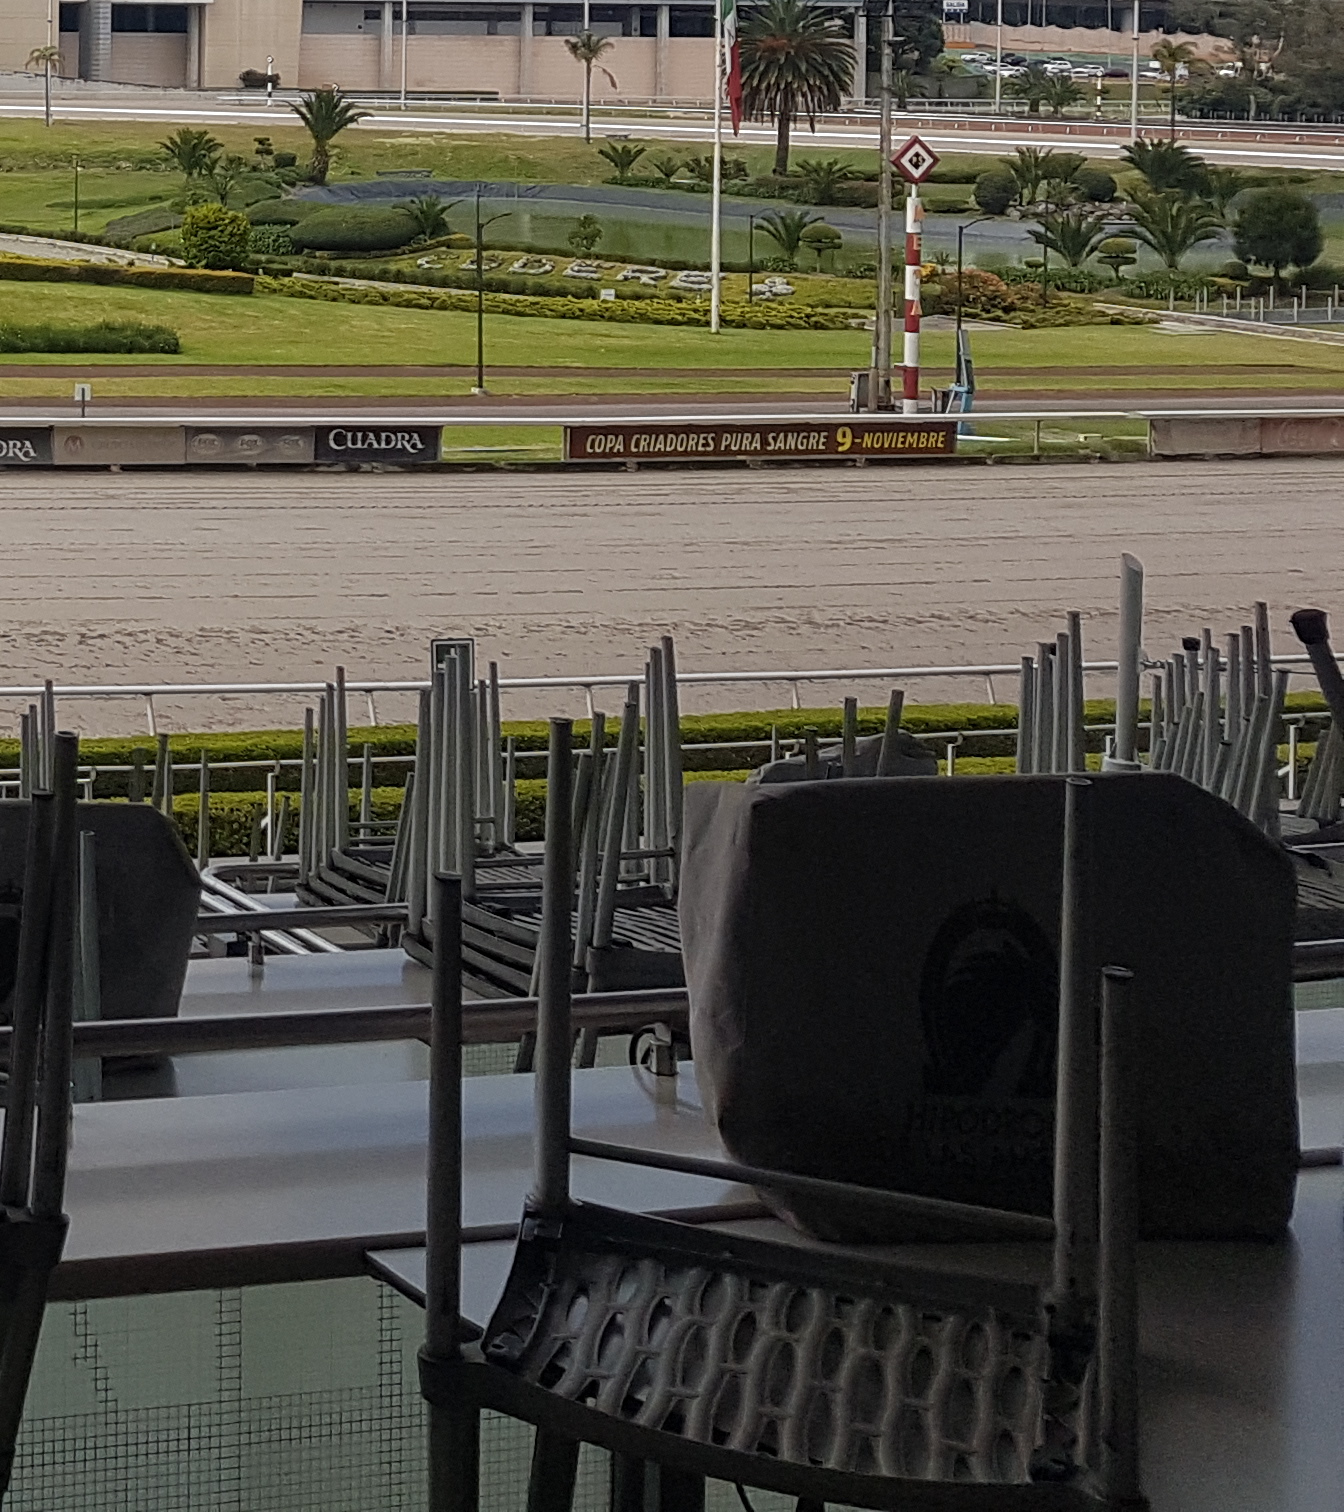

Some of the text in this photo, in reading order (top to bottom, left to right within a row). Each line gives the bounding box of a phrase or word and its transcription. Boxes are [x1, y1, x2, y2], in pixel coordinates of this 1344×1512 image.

[328, 428, 425, 453] CUADRA
[586, 434, 625, 453] COPA
[630, 433, 715, 453] CRIADORES
[720, 433, 762, 451] PURA
[766, 432, 828, 451] SANGRE
